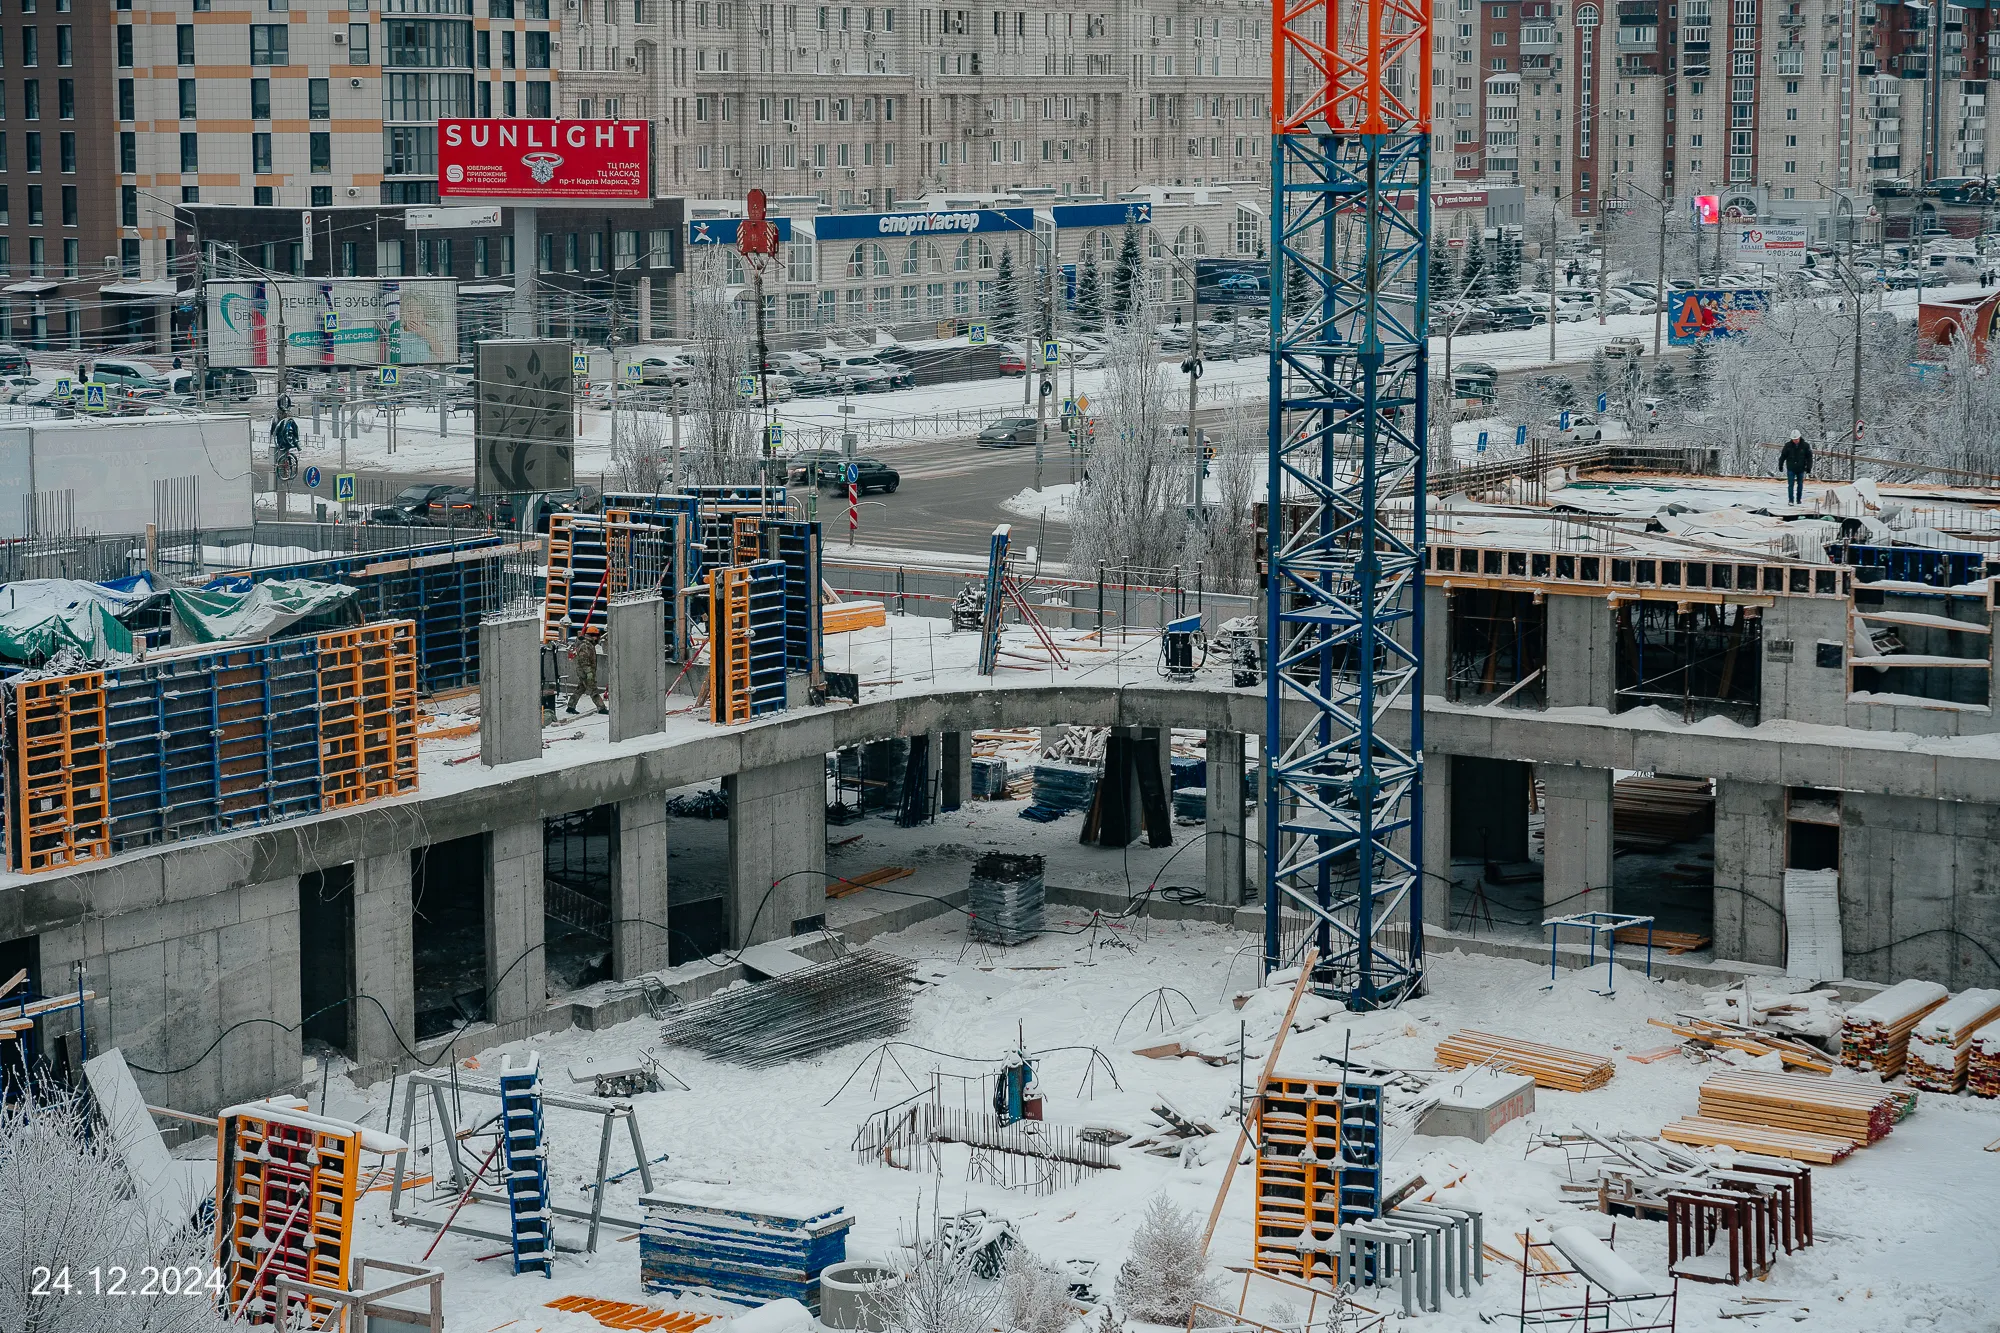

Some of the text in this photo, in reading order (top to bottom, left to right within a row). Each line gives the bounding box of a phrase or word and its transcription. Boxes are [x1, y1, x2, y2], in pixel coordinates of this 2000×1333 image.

[446, 125, 640, 148] SUNLIGHT
[609, 170, 640, 178] КАСКАД
[576, 178, 598, 186] Карла
